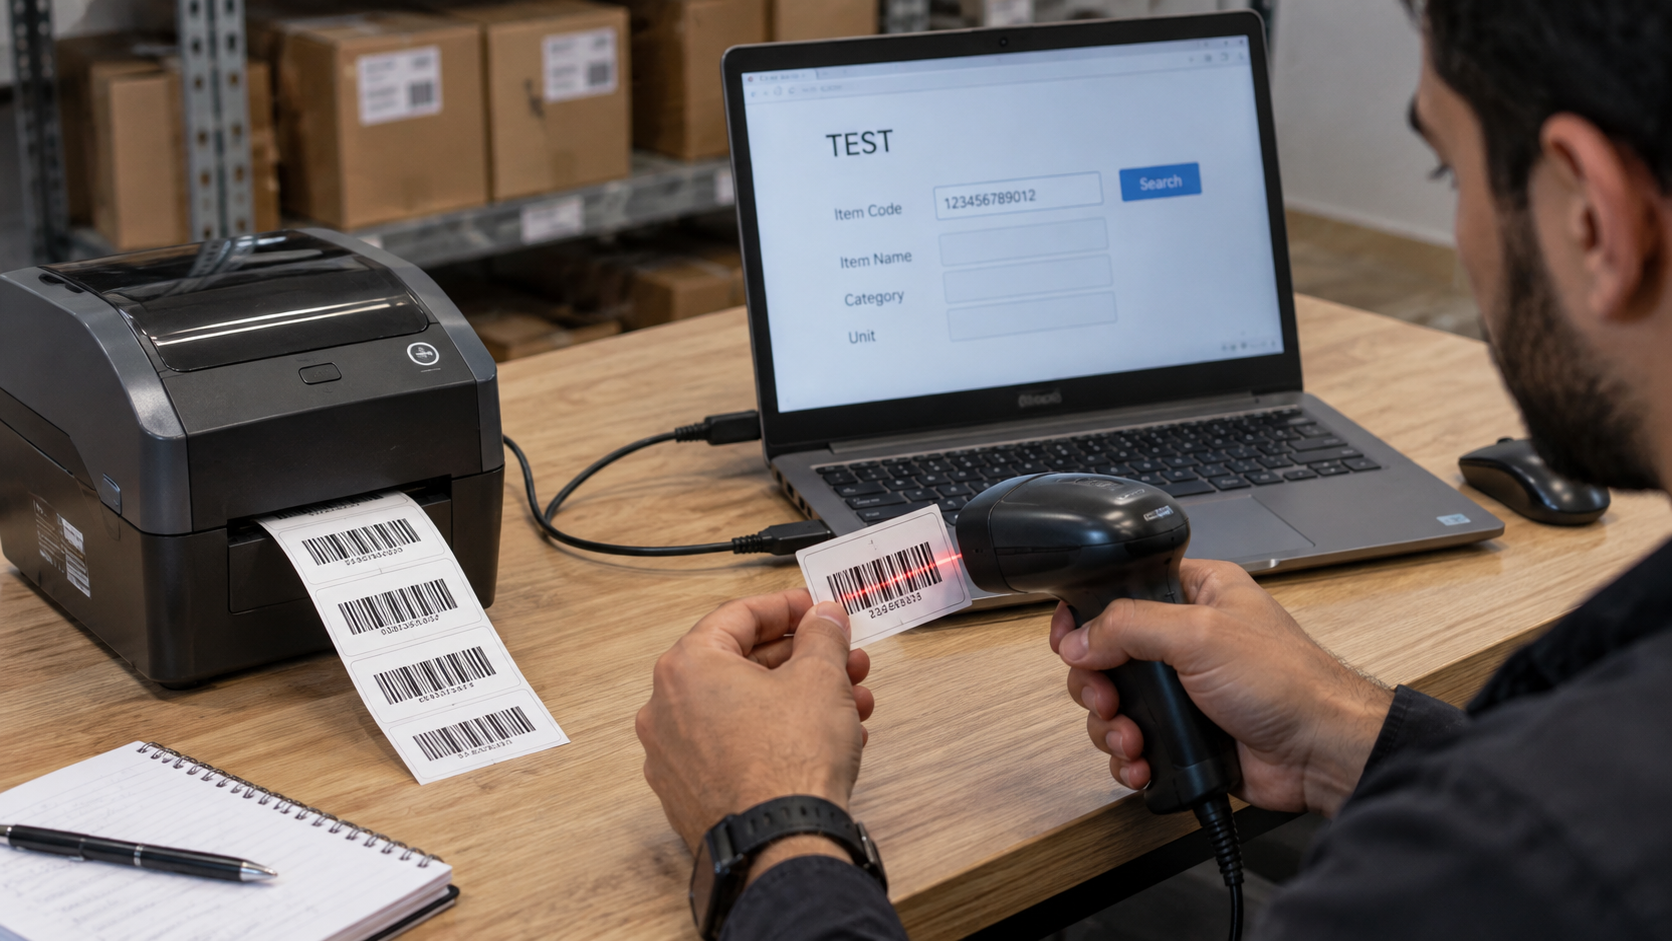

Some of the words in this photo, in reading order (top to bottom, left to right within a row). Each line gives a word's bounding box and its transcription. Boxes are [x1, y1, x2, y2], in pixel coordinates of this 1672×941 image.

[825, 128, 894, 157] TEST
[1139, 173, 1183, 192] Search
[944, 189, 1036, 210] 123456789012
[834, 207, 865, 222] Item
[868, 202, 903, 219] Code
[840, 255, 871, 270] Item
[873, 250, 913, 267] Name
[844, 288, 905, 308] Category
[848, 328, 876, 345] Unit
